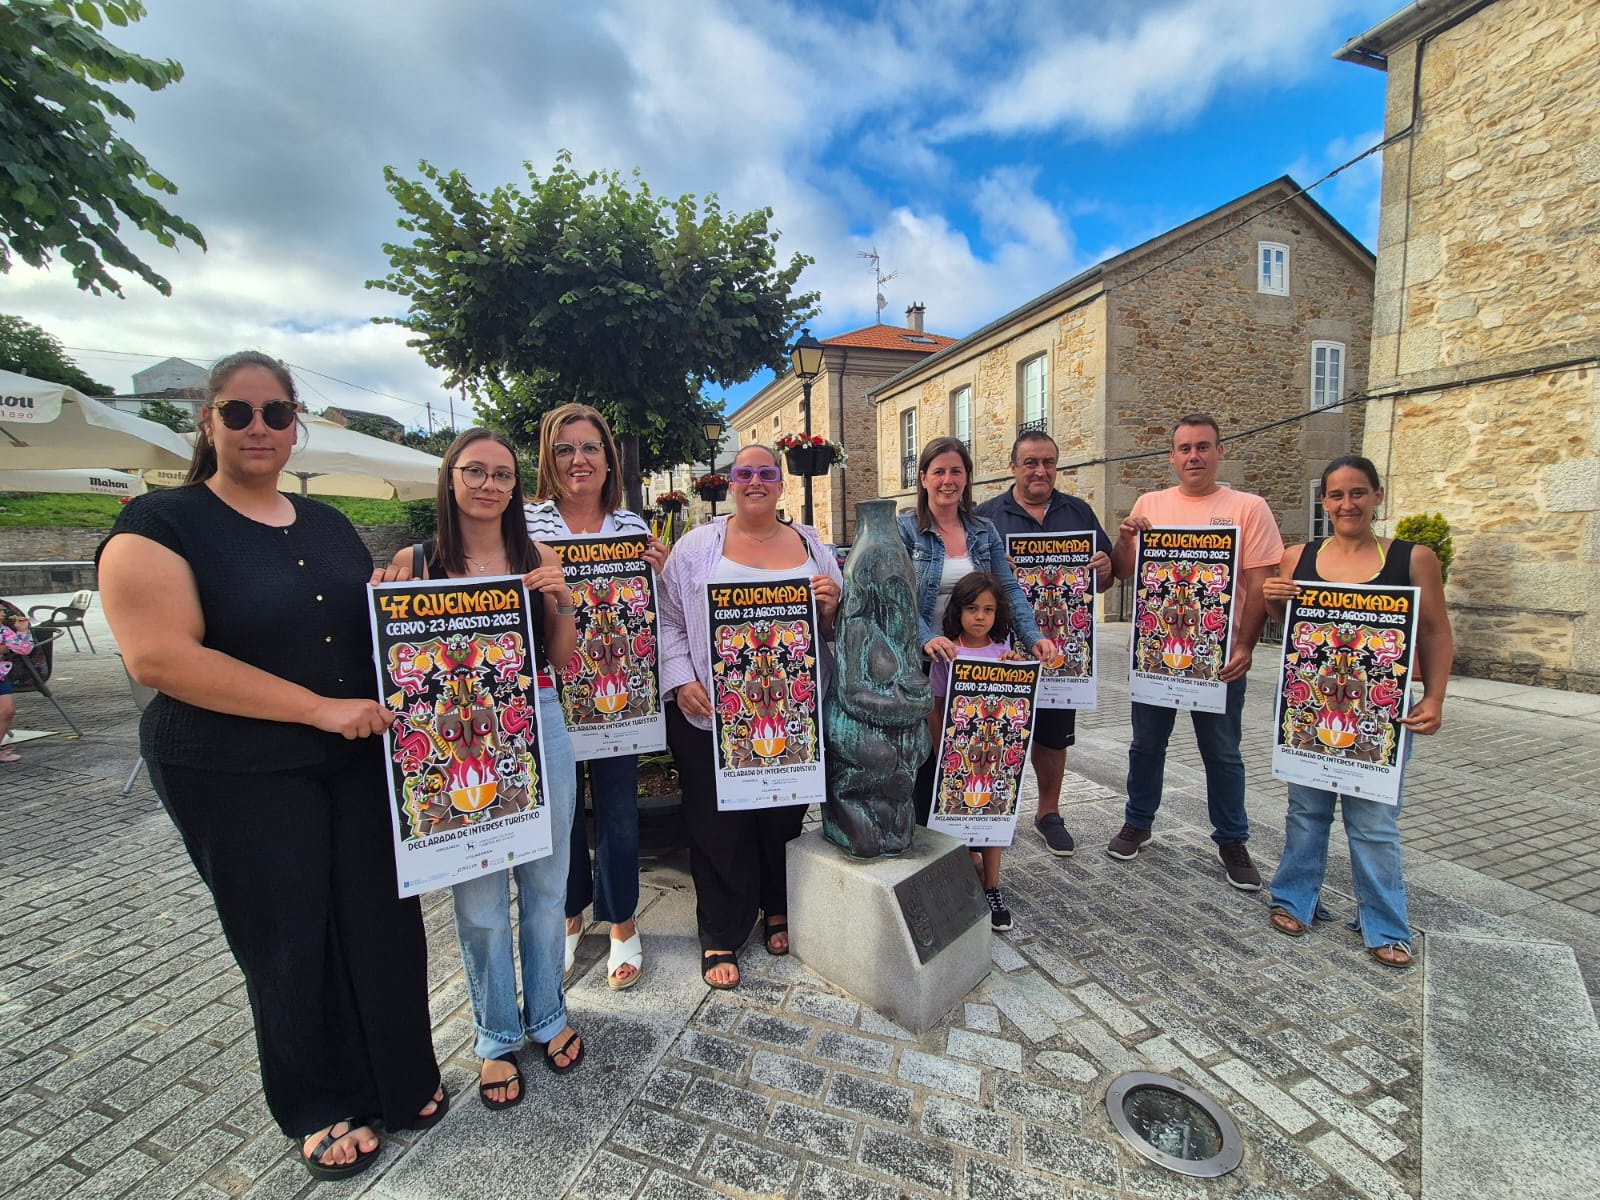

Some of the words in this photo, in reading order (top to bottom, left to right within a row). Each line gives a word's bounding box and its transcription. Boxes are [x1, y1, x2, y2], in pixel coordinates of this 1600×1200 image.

[89, 476, 128, 489] Mahou
[1011, 540, 1027, 554] 47
[1028, 539, 1090, 554] QUEIMADA
[1143, 533, 1162, 548] 47
[1161, 533, 1232, 549] QUEIMADA
[552, 545, 566, 564] 7
[568, 542, 645, 563] QUEIMADA
[379, 594, 411, 620] 47
[413, 589, 521, 617] QUEIMADA
[711, 589, 732, 608] 47
[733, 585, 808, 607] QUEIMADA
[1319, 591, 1409, 612] QUEIMADA
[955, 664, 972, 680] 47
[972, 665, 1035, 683] QUEIMADA
[1281, 747, 1317, 759] DECLARADA
[1326, 756, 1355, 768] INTERESE
[407, 832, 457, 851] DECLARADA
[457, 830, 469, 839] DE
[469, 820, 504, 837] INTERESE
[505, 810, 540, 826] TURÍSTICO
